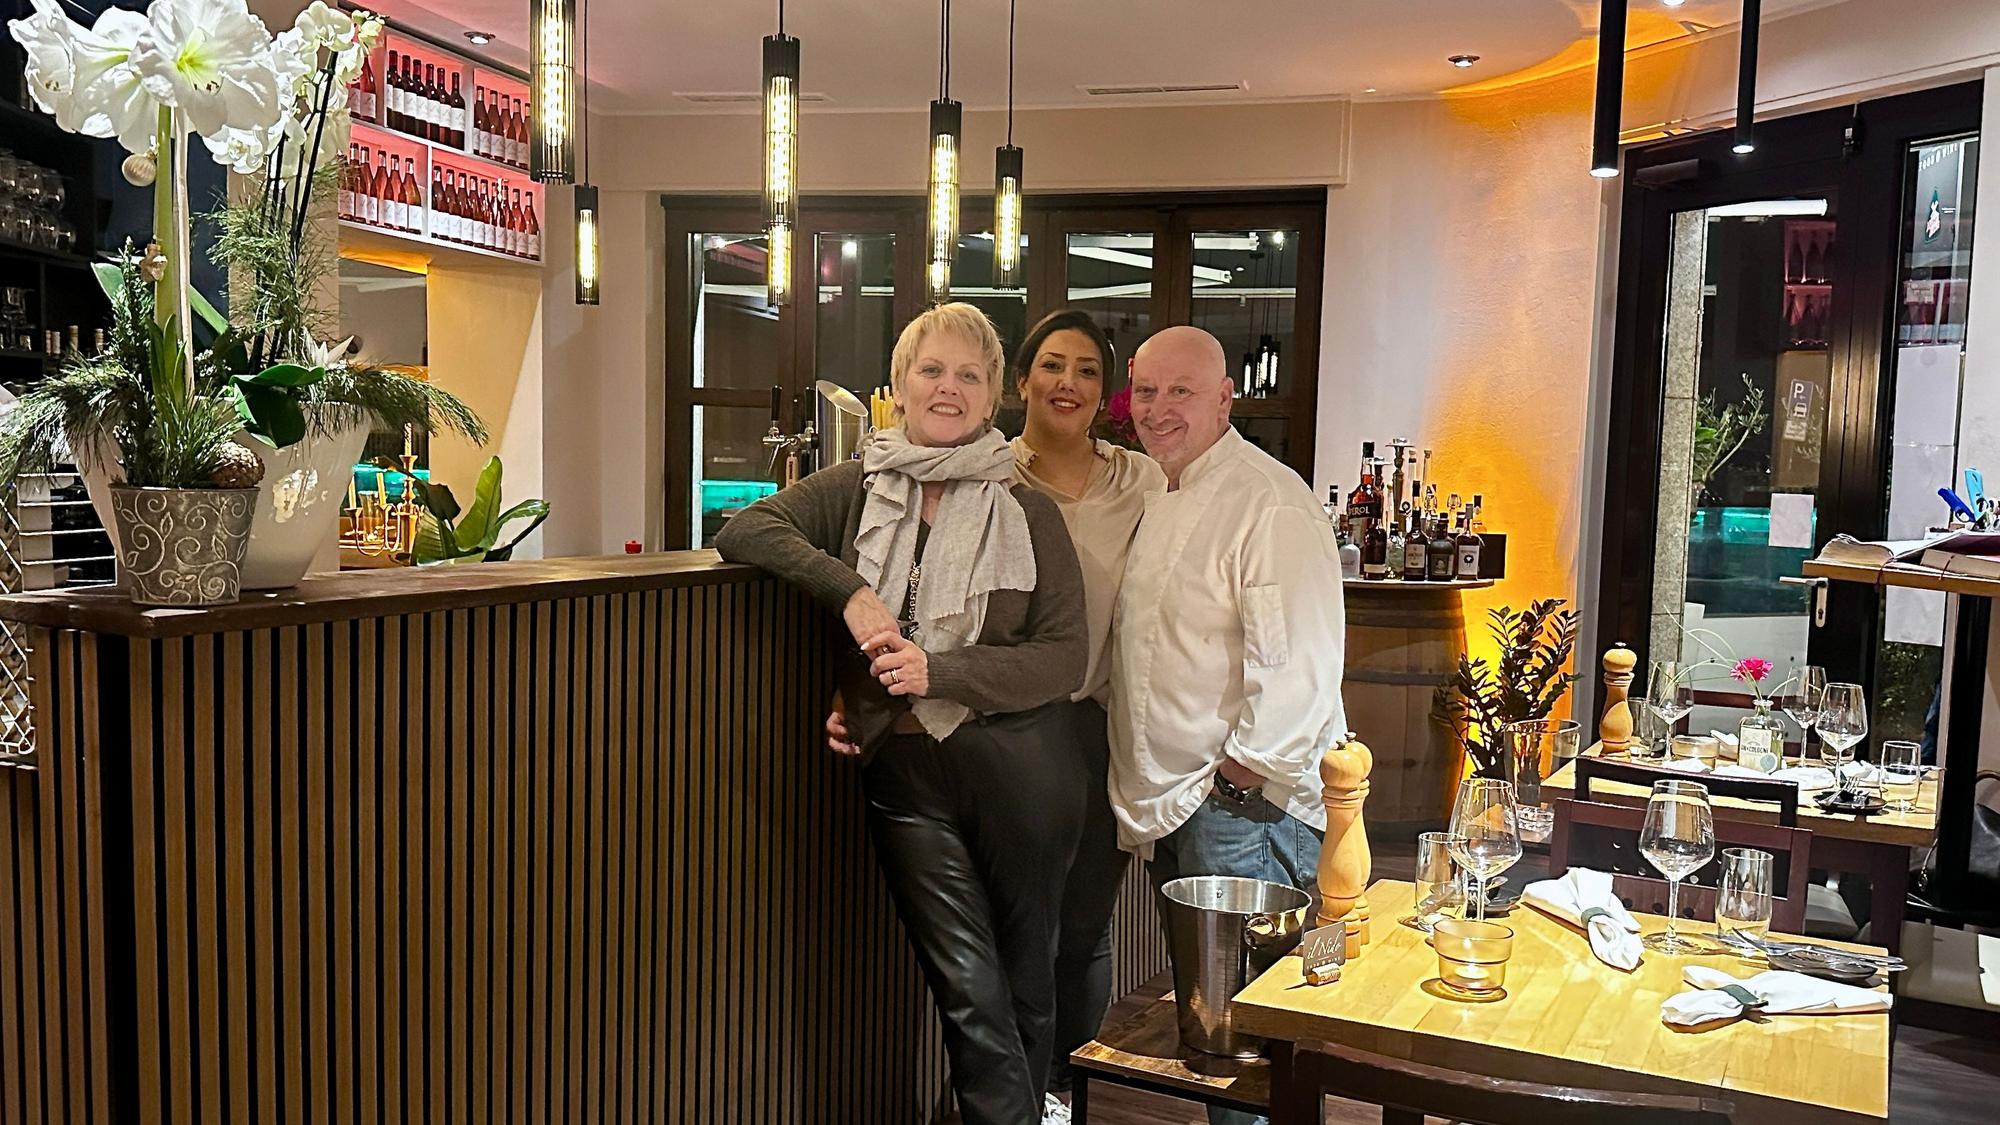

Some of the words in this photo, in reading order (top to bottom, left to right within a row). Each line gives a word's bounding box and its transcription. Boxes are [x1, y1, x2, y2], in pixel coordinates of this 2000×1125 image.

[1794, 383, 1804, 398] P
[1307, 936, 1321, 960] il
[1318, 930, 1343, 956] Nido
